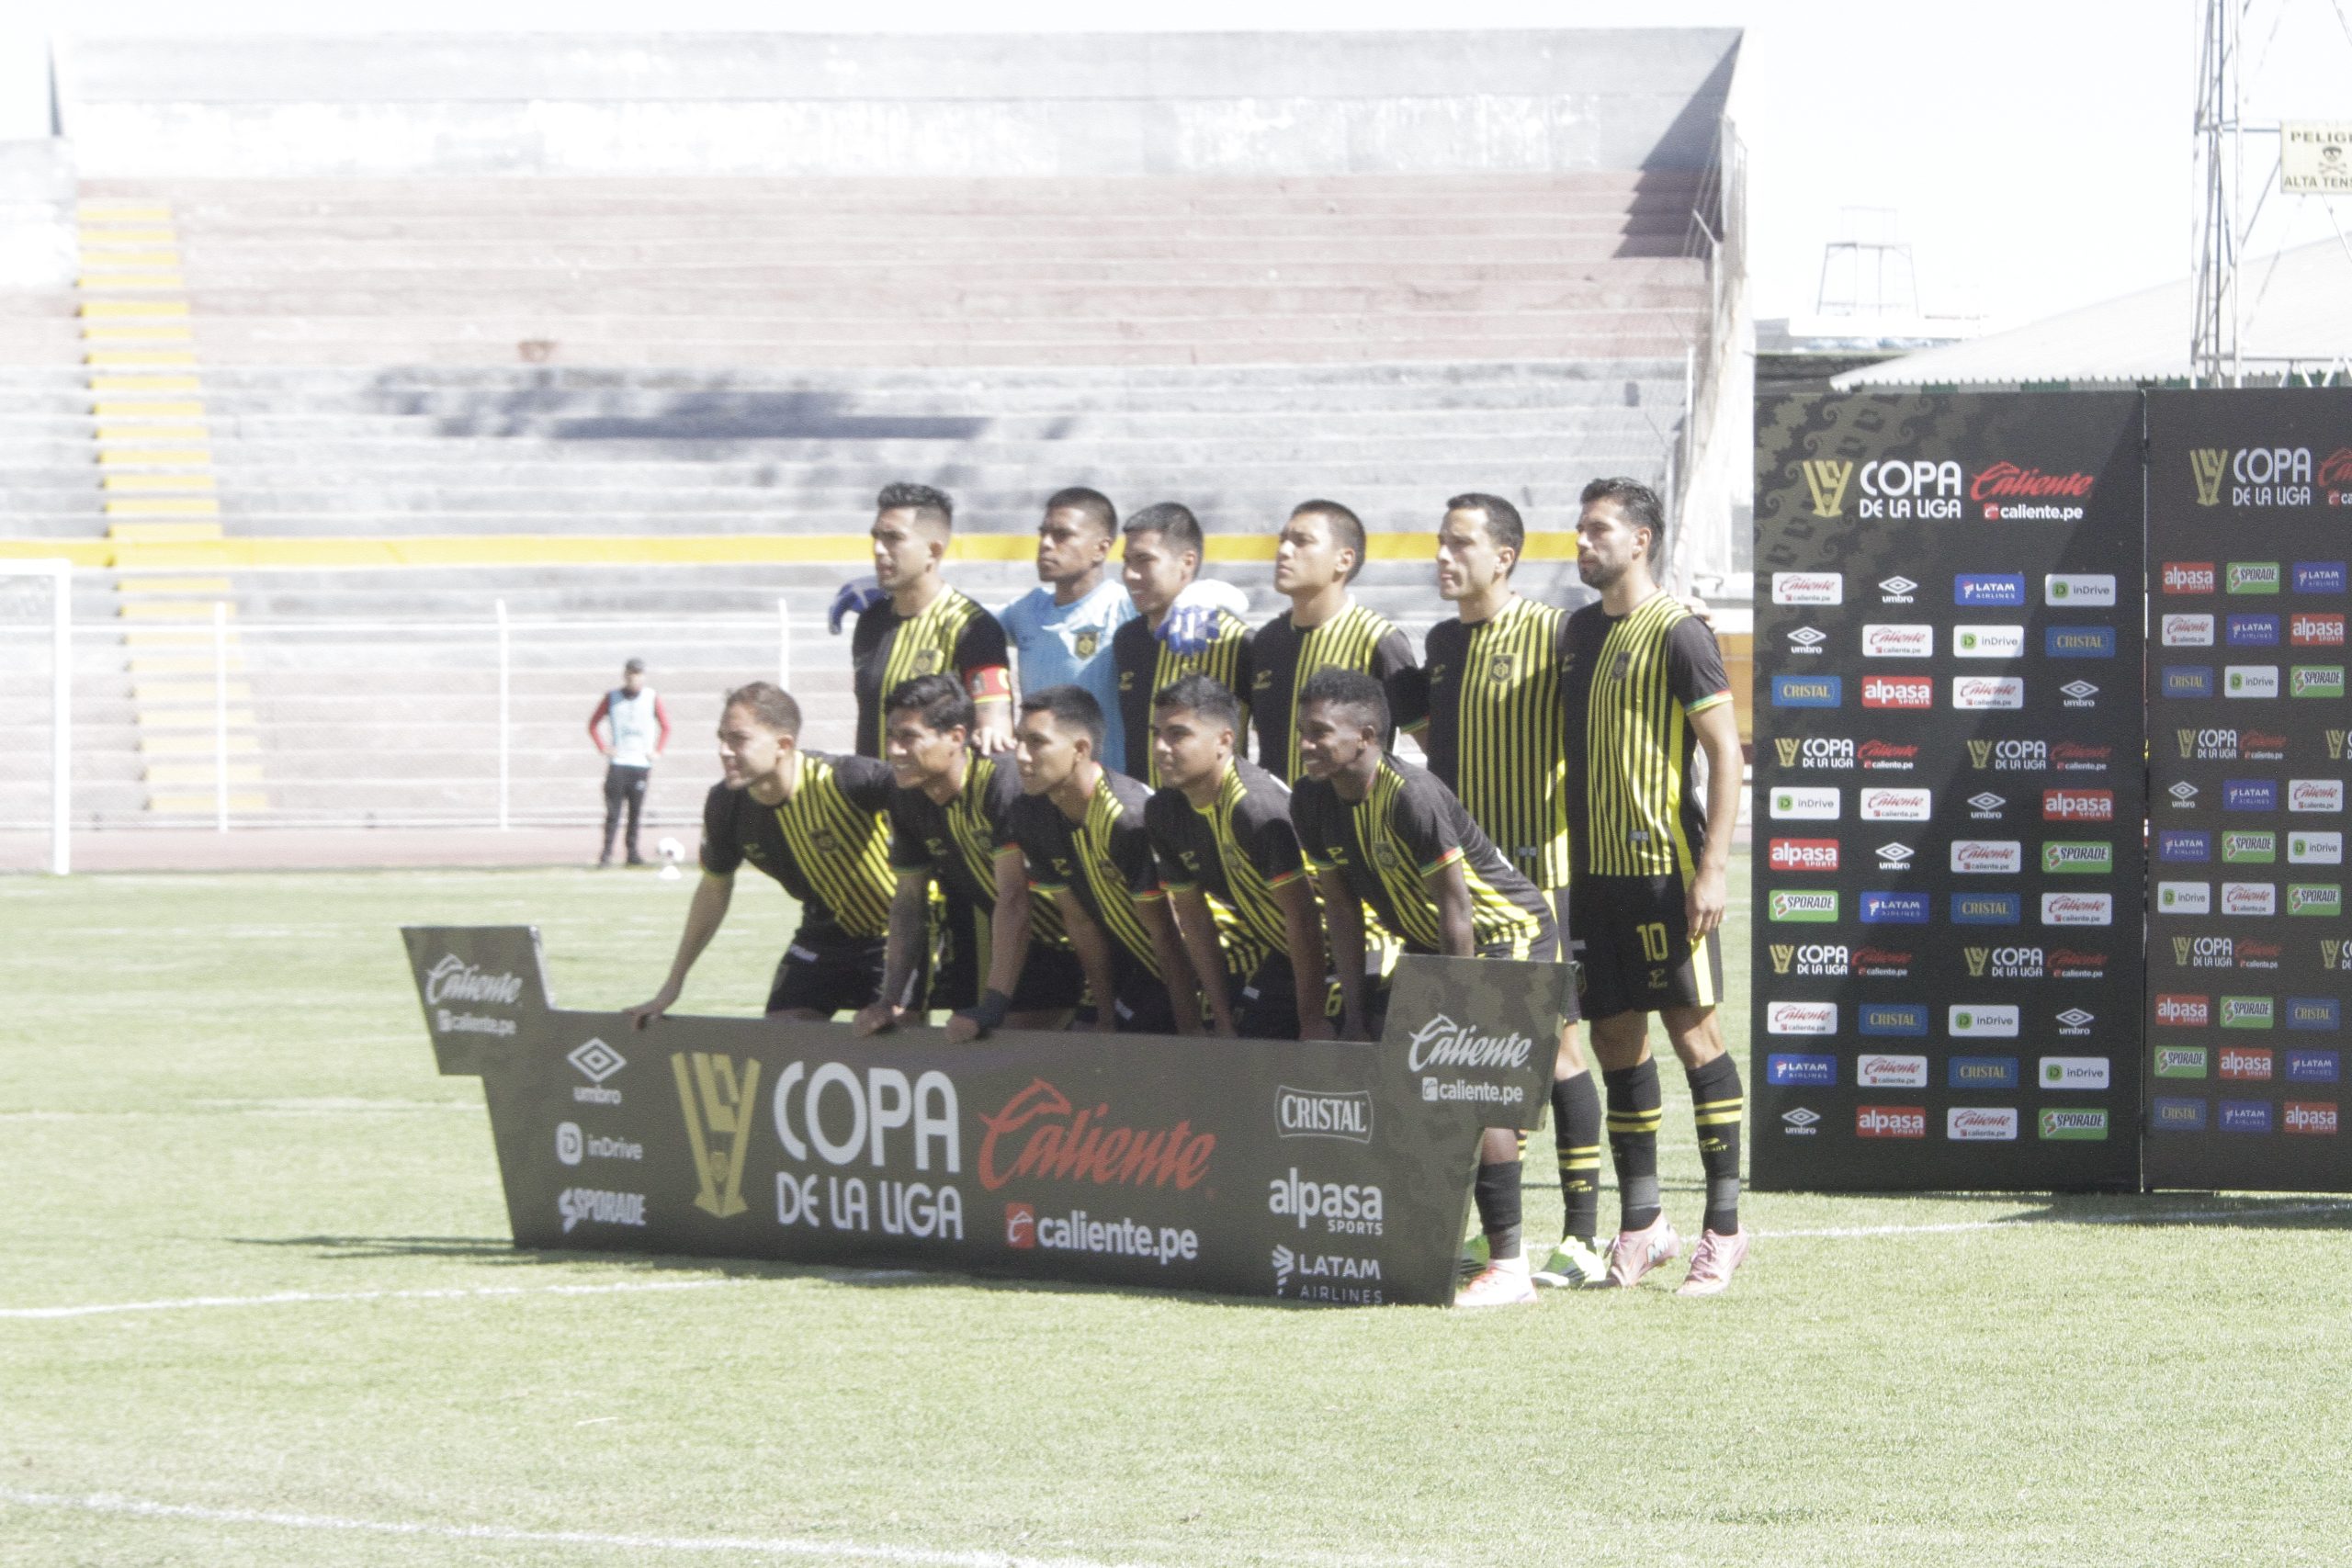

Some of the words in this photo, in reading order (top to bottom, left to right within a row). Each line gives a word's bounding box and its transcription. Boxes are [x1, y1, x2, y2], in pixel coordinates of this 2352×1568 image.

[2284, 175, 2317, 187] ALTA
[2233, 448, 2311, 483] COPA
[1860, 461, 1962, 496] COPA
[1971, 462, 2095, 500] Caliente
[2233, 486, 2250, 506] DE
[2256, 486, 2271, 505] LA
[2277, 486, 2311, 506] LIGA
[1860, 500, 1883, 518] DE
[1890, 500, 1911, 518] LA
[1917, 500, 1962, 518] LIGA
[2000, 504, 2083, 521] caliente.pe
[2165, 567, 2213, 587] alpasa
[2240, 567, 2275, 581] SPORADE
[2309, 570, 2339, 580] LATAM
[1779, 575, 1837, 592] Caliente
[1975, 583, 2015, 592] LATAM
[2073, 585, 2109, 595] inDrive
[1883, 595, 1914, 604] umbro
[2243, 623, 2272, 632] LATAM
[2293, 617, 2343, 639] alpasa
[1870, 627, 1926, 645] Caliente
[1982, 636, 2018, 647] inDrive
[2057, 636, 2102, 648] CRISTAL
[1792, 646, 1822, 654] umbro
[2245, 676, 2274, 687] inDrive
[2304, 671, 2340, 684] SPORADE
[1783, 685, 1830, 698] CRISTAL
[1865, 680, 1929, 703] alpasa
[1961, 680, 2017, 697] Caliente
[2064, 698, 2095, 706] umbro
[2199, 729, 2236, 748] COPA
[1803, 739, 1854, 757] COPA
[1858, 740, 1920, 758] Caliente
[1996, 740, 2046, 758] COPA
[2198, 749, 2206, 758] DE
[2209, 749, 2217, 758] LA
[2220, 749, 2236, 759] LIGA
[1803, 759, 1814, 767] DE
[1817, 759, 1828, 768] LA
[1832, 759, 1854, 769] LIGA
[1996, 760, 2007, 769] DE
[2010, 760, 2021, 769] LA
[2024, 760, 2046, 770] LIGA
[1868, 791, 1924, 808] Caliente
[2239, 788, 2269, 797] LATAM
[1798, 799, 1834, 809] inDrive
[2046, 793, 2111, 816] alpasa
[1971, 811, 2001, 819] umbro
[1957, 843, 2014, 860] Caliente
[2174, 840, 2203, 848] LATAM
[2235, 836, 2272, 852] SPORADE
[2309, 842, 2337, 853] inDrive
[1772, 842, 1837, 866] alpasa
[2060, 848, 2107, 860] SPORADE
[1879, 862, 1910, 870] umbro
[1787, 896, 1833, 909] SPORADE
[1882, 900, 1920, 908] LATAM
[2048, 896, 2105, 913] Caliente
[2178, 893, 2205, 903] inDrive
[2301, 889, 2337, 904] SPORADE
[1962, 902, 2009, 915] CRISTAL
[1636, 922, 1668, 962] 10
[2194, 938, 2232, 956] COPA
[1797, 946, 1848, 964] COPA
[1992, 948, 2043, 966] COPA
[2194, 956, 2202, 965] DE
[2204, 956, 2212, 966] LA
[2215, 957, 2232, 967] LIGA
[1797, 964, 1809, 975] DE
[1813, 964, 1824, 975] LA
[1826, 964, 1848, 975] LIGA
[1992, 966, 2004, 976] DE
[2007, 966, 2018, 976] LA
[2020, 967, 2043, 977] LIGA
[1775, 1005, 1830, 1022] Caliente
[2158, 998, 2207, 1021] alpasa
[2233, 1001, 2269, 1016] SPORADE
[1870, 1013, 1917, 1026] CRISTAL
[1977, 1015, 2013, 1026] inDrive
[2059, 1027, 2090, 1035] umbro
[1408, 1013, 1532, 1072] Caliente
[1864, 1057, 1920, 1075] Caliente
[2167, 1051, 2204, 1066] SPORADE
[2222, 1051, 2271, 1074] alpasa
[1789, 1063, 1827, 1071] LATAM
[1961, 1066, 2007, 1078] CRISTAL
[2067, 1067, 2103, 1077] inDrive
[1440, 1080, 1523, 1105] caliente.pe
[775, 1061, 960, 1173] COPA
[1282, 1094, 1366, 1133] CRISTAL
[1860, 1110, 1924, 1133] alpasa
[1955, 1111, 2009, 1128] Caliente
[2057, 1114, 2103, 1127] SPORADE
[2234, 1109, 2265, 1118] LATAM
[2286, 1106, 2335, 1128] alpasa
[978, 1078, 1216, 1190] Caliente
[1785, 1126, 1815, 1134] umbro
[588, 1134, 642, 1160] inDrive
[777, 1172, 820, 1227] DE
[831, 1178, 869, 1232] LA
[881, 1181, 963, 1240] LIGA
[1269, 1168, 1382, 1229] alpasa
[1329, 1219, 1382, 1235] SPORTS
[1037, 1211, 1198, 1263] caliente.pe
[1300, 1254, 1381, 1280] LATAM
[1300, 1285, 1382, 1303] AIRLINES
